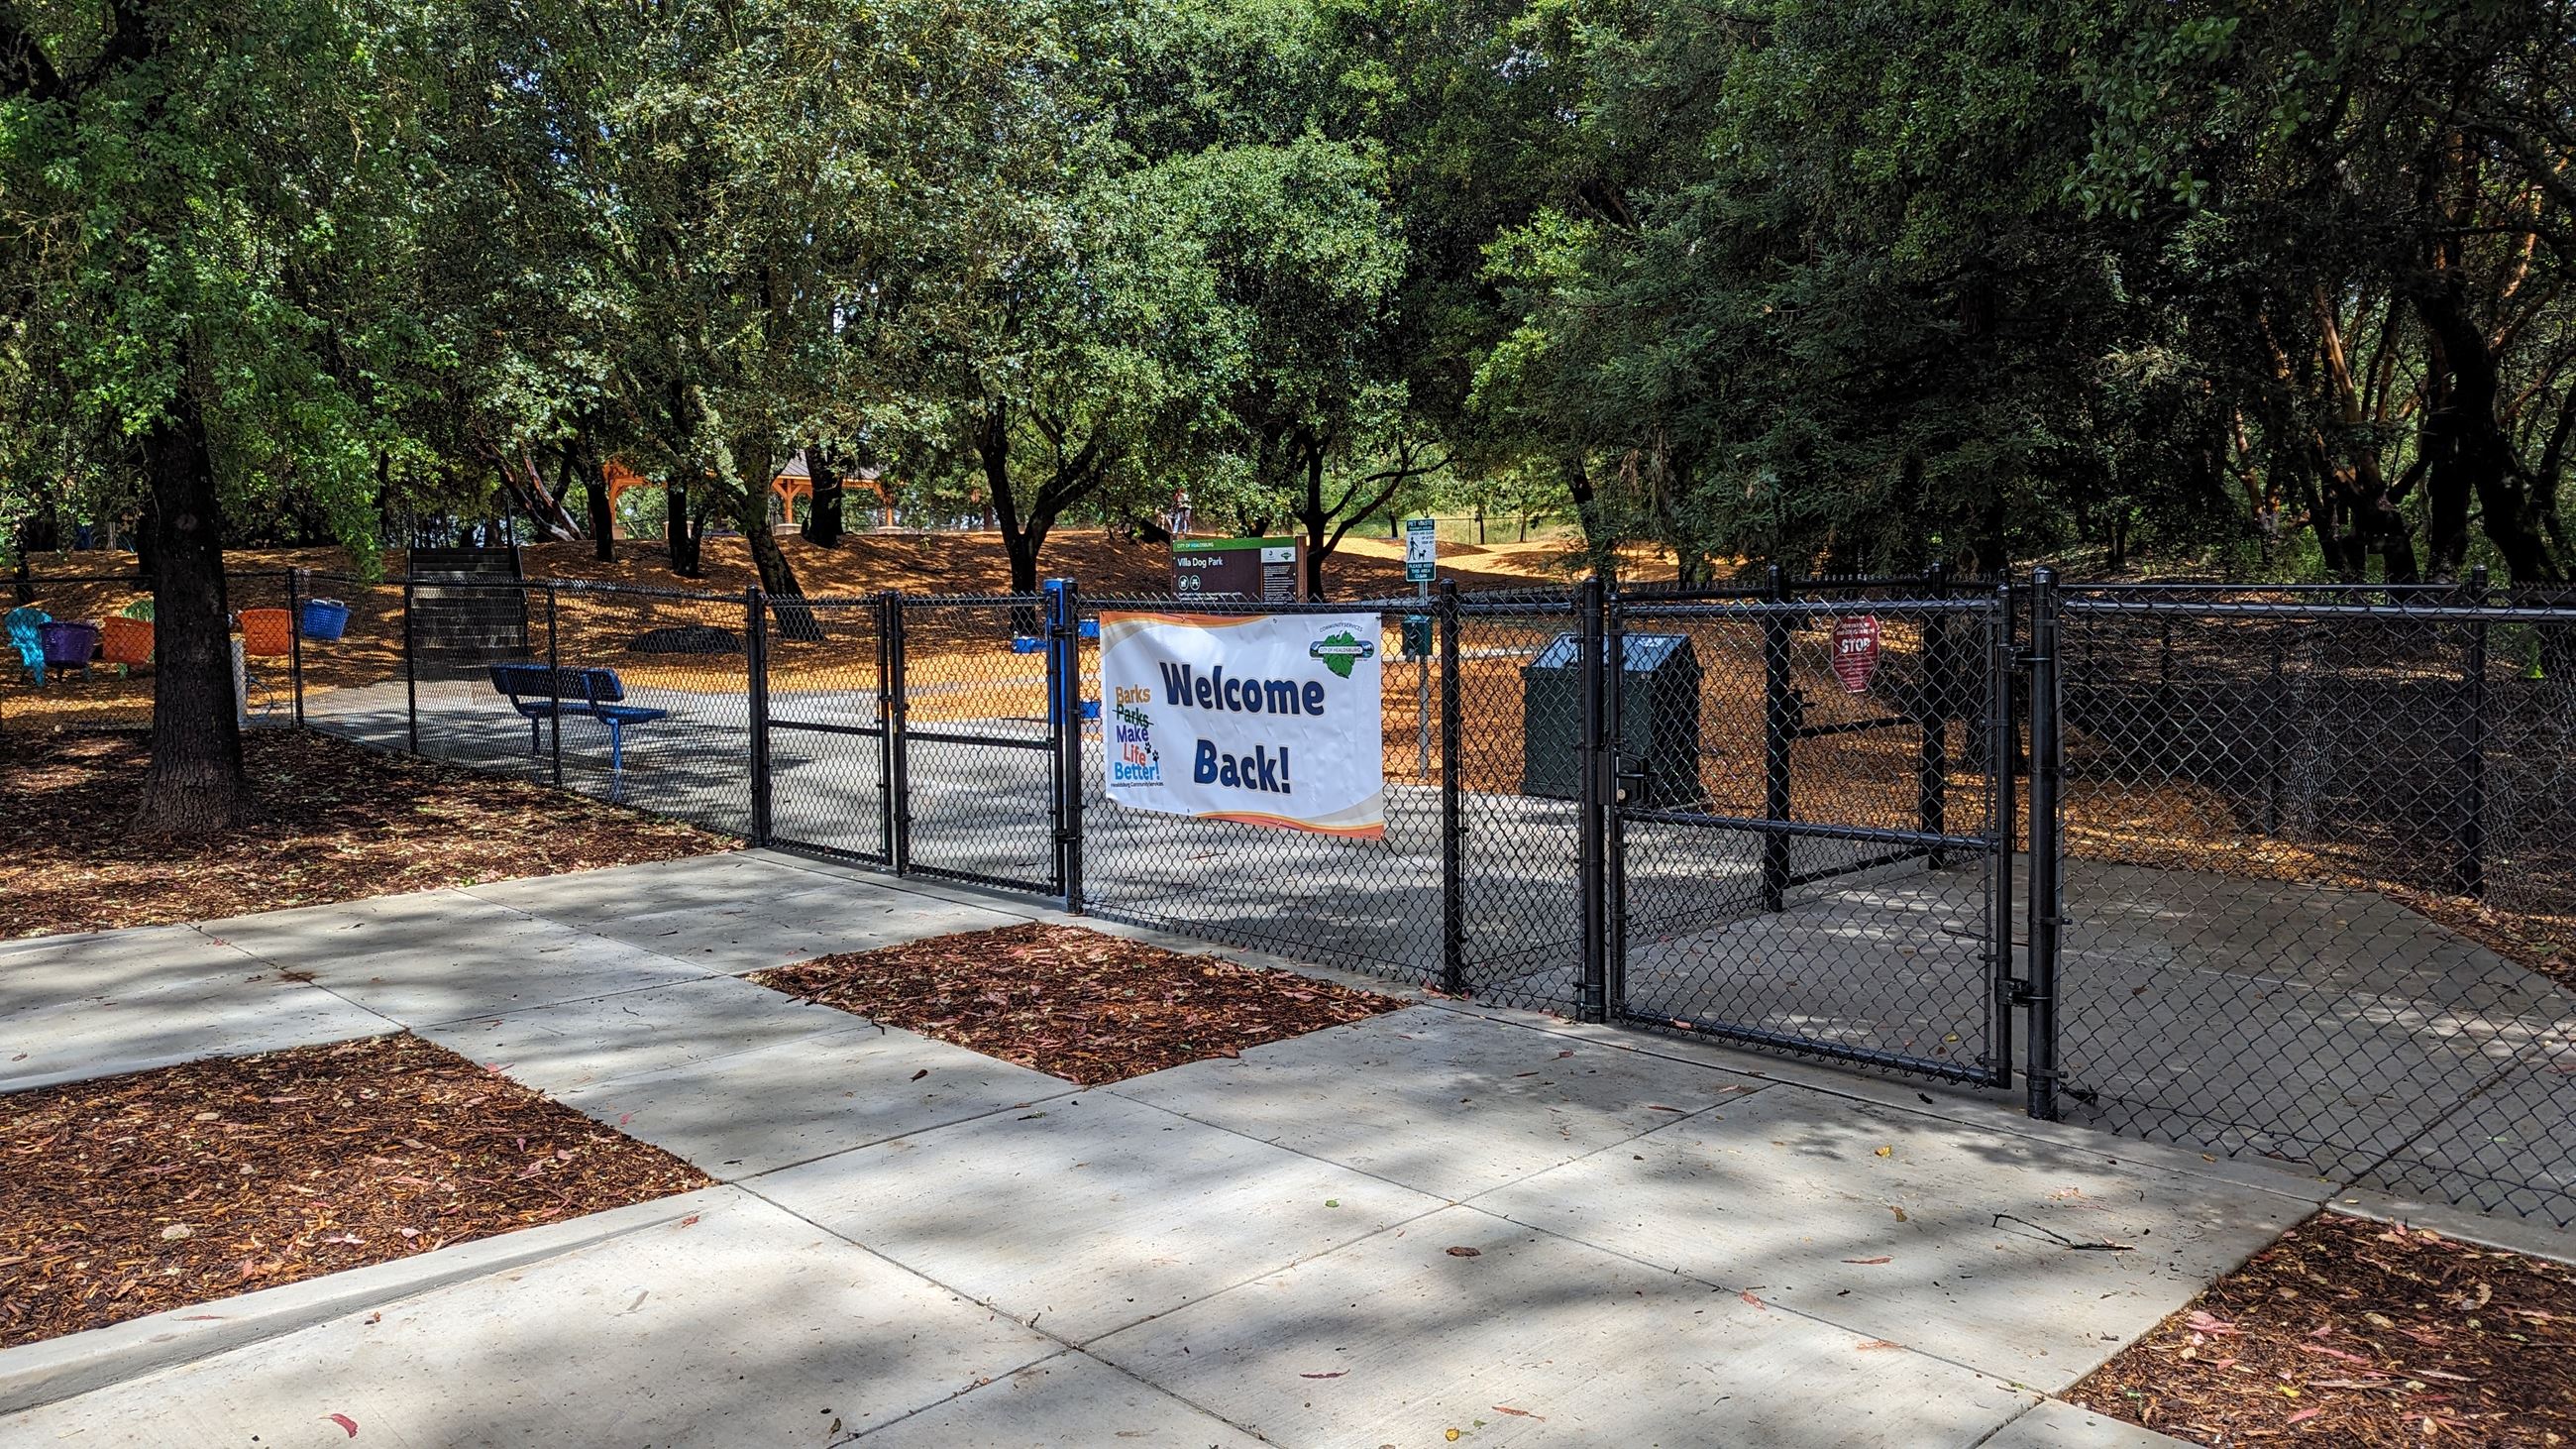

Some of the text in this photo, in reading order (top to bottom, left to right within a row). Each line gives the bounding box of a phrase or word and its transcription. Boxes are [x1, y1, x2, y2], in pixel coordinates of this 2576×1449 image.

[1177, 556, 1223, 568] Villa Dog Park
[1319, 622, 1363, 632] COMMUNITY SERVICES
[1842, 637, 1871, 654] STOP
[1116, 684, 1150, 705] Barks
[1158, 661, 1326, 717] Welcome
[1116, 703, 1149, 728] Parks
[1116, 724, 1149, 743] Make
[1124, 742, 1146, 767] Life
[1115, 760, 1160, 781] Better!
[1193, 738, 1292, 794] Back!
